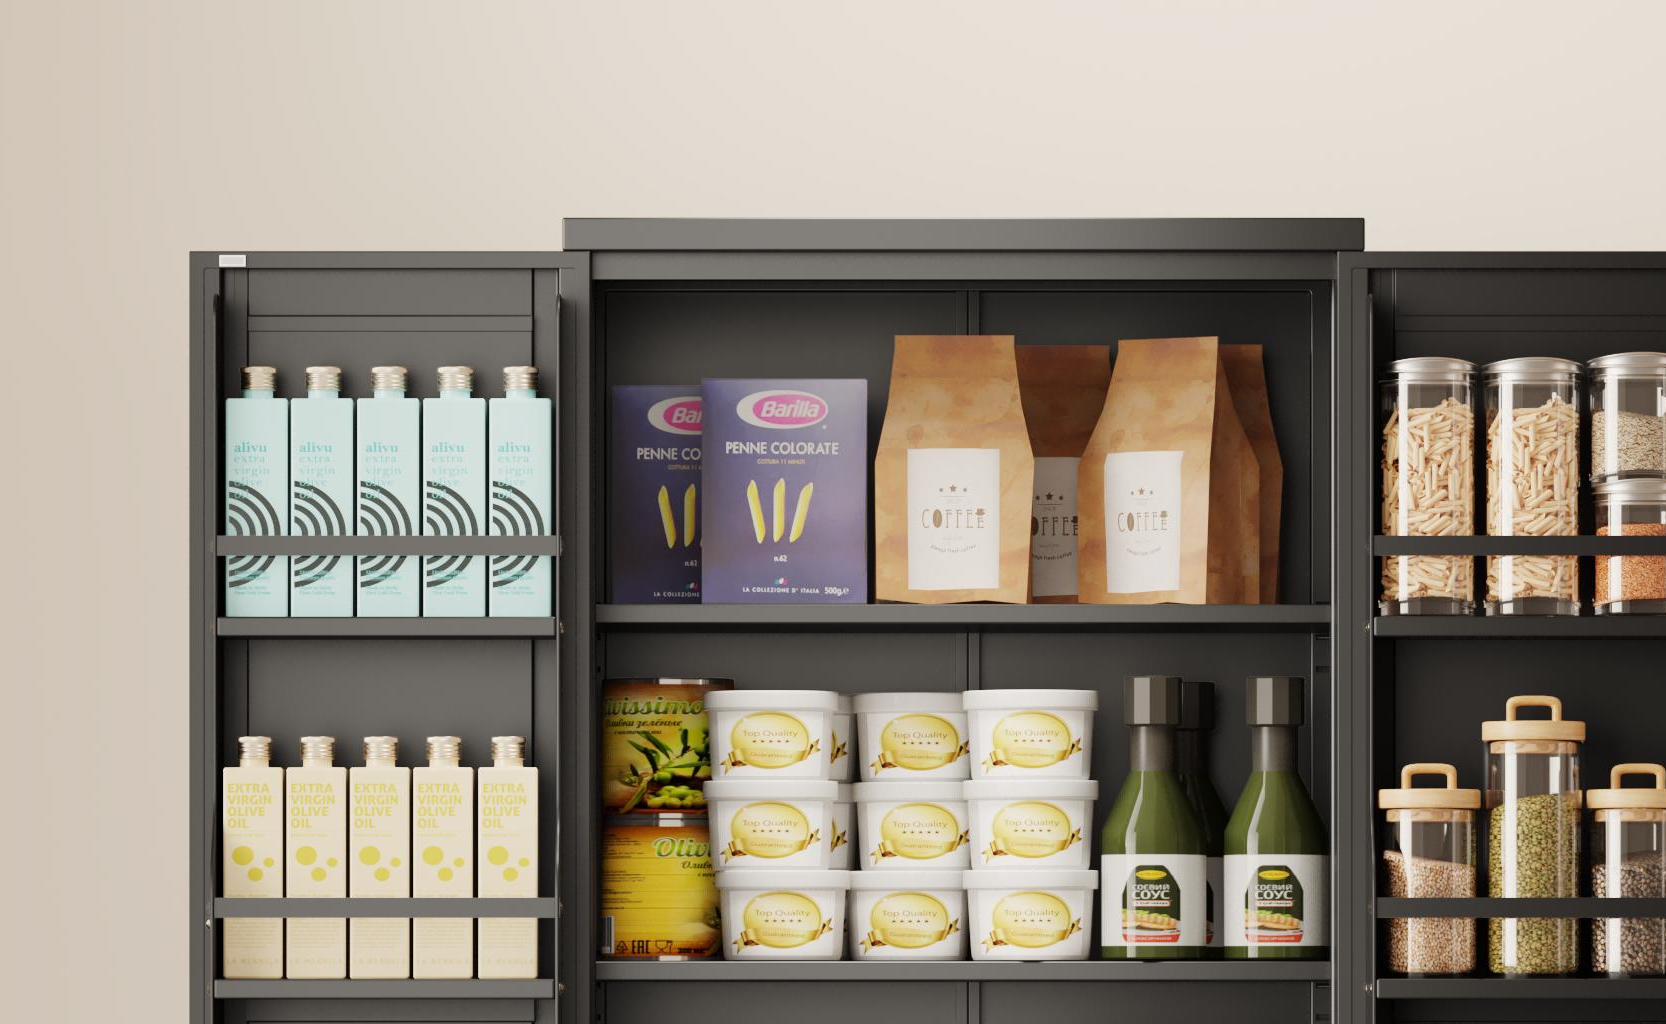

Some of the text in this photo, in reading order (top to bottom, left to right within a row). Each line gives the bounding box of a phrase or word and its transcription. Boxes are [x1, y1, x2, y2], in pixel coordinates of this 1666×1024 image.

[761, 400, 820, 418] Barilla
[234, 441, 267, 452] alivu
[299, 441, 332, 452] alivu
[365, 441, 398, 452] alivu
[431, 441, 464, 452] alivu
[497, 441, 530, 452] alivu
[725, 441, 839, 455] PENNE COLORATE
[637, 447, 678, 460] PENNE
[227, 783, 269, 793] EXTRA
[290, 783, 332, 793] EXTRA
[354, 783, 396, 793] EXTRA
[417, 783, 459, 793] EXTRA
[482, 783, 524, 793] EXTRA
[227, 795, 273, 805] VIRGIN
[290, 795, 336, 805] VIRGIN
[354, 795, 400, 805] VIRGIN
[417, 795, 463, 805] VIRGIN
[482, 795, 528, 805] VIRGIN
[227, 806, 266, 817] OLIVE
[290, 806, 329, 817] OLIVE
[354, 806, 393, 817] OLIVE
[417, 806, 456, 817] OLIVE
[482, 806, 521, 817] OLIVE
[227, 818, 249, 829] OIL
[290, 818, 312, 829] OIL
[354, 818, 376, 829] OIL
[417, 818, 439, 829] OIL
[482, 818, 504, 829] OIL
[1132, 890, 1171, 900] СОУС
[1255, 890, 1294, 900] СОУС
